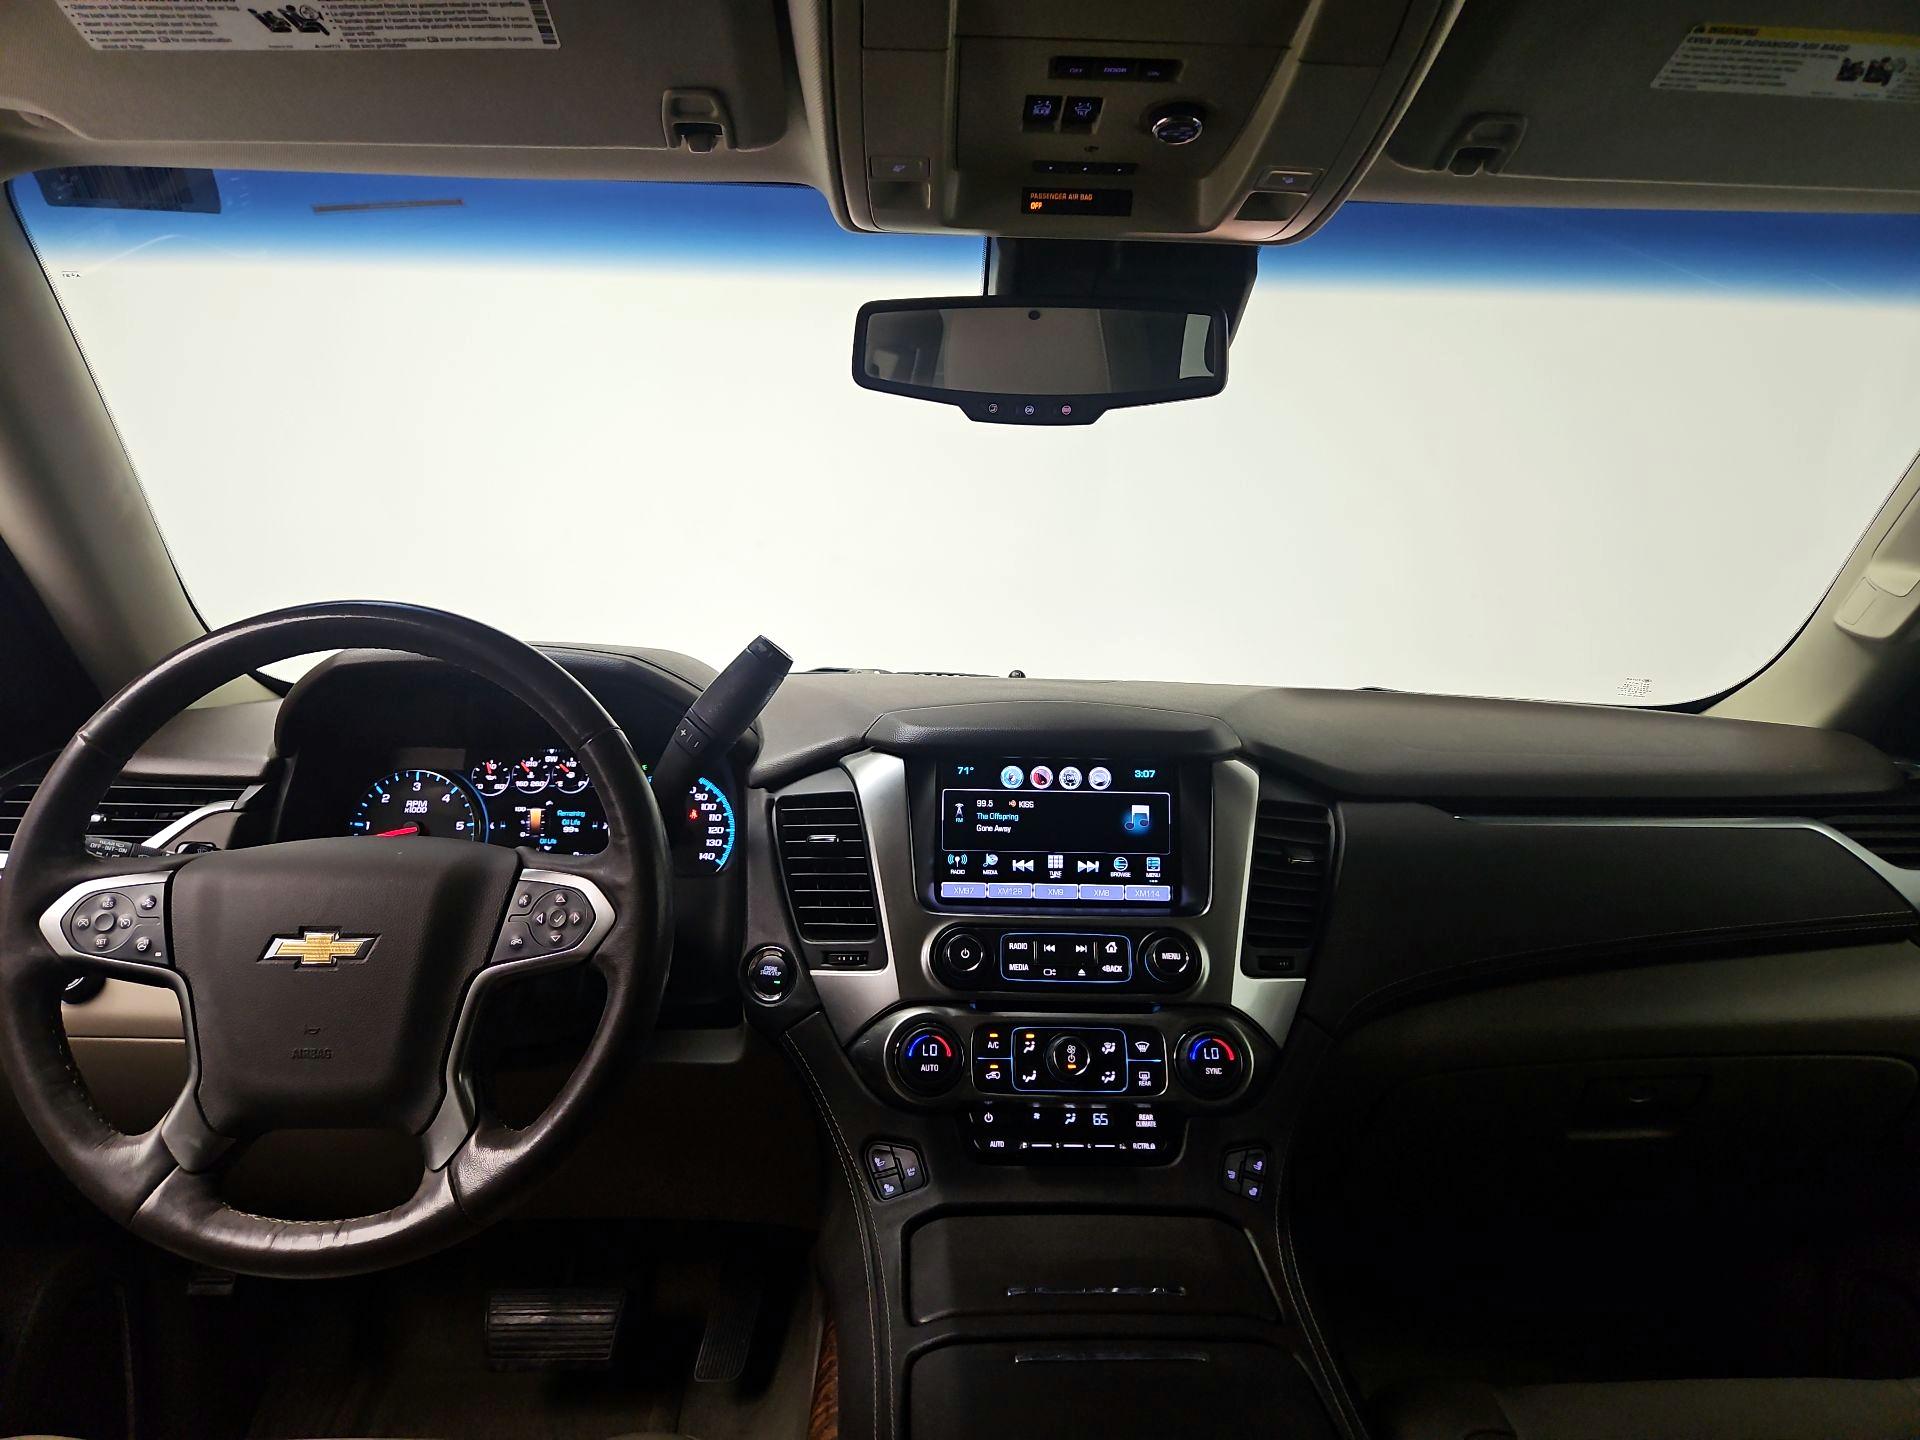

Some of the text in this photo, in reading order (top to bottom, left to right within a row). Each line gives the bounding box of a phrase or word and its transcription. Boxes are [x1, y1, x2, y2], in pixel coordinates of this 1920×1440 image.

[1030, 192, 1067, 201] PASSENGER
[1068, 193, 1079, 201] AIR
[1030, 201, 1043, 210] OFF
[1134, 769, 1156, 778] 3:07
[412, 782, 421, 792] 3
[381, 793, 391, 803] 2
[441, 794, 451, 803] 4
[694, 793, 708, 801] 90
[405, 800, 428, 808] RPM
[701, 803, 717, 811] 100
[976, 800, 994, 808] 99.5
[1018, 801, 1035, 809] KISS
[557, 809, 585, 818] Remaining
[709, 813, 722, 822] 110
[976, 812, 1019, 822] The Offspring
[455, 821, 465, 831] 5
[708, 826, 724, 834] 120
[976, 824, 1012, 834] Gone Away
[706, 839, 722, 847] 130
[699, 852, 715, 861] 140
[96, 938, 107, 946] SET
[1008, 942, 1028, 950] RADIO
[1161, 952, 1181, 960] MENU
[1008, 963, 1029, 971] MEDIA
[1105, 965, 1123, 973] BACK
[987, 1041, 1000, 1049] A/C
[920, 1064, 939, 1072] AUTO
[1205, 1067, 1223, 1075] SYNC
[1092, 1112, 1109, 1126] 65
[1138, 1113, 1154, 1121] REAR
[1135, 1120, 1157, 1128] CLIMATE
[989, 1140, 1005, 1148] AUTO
